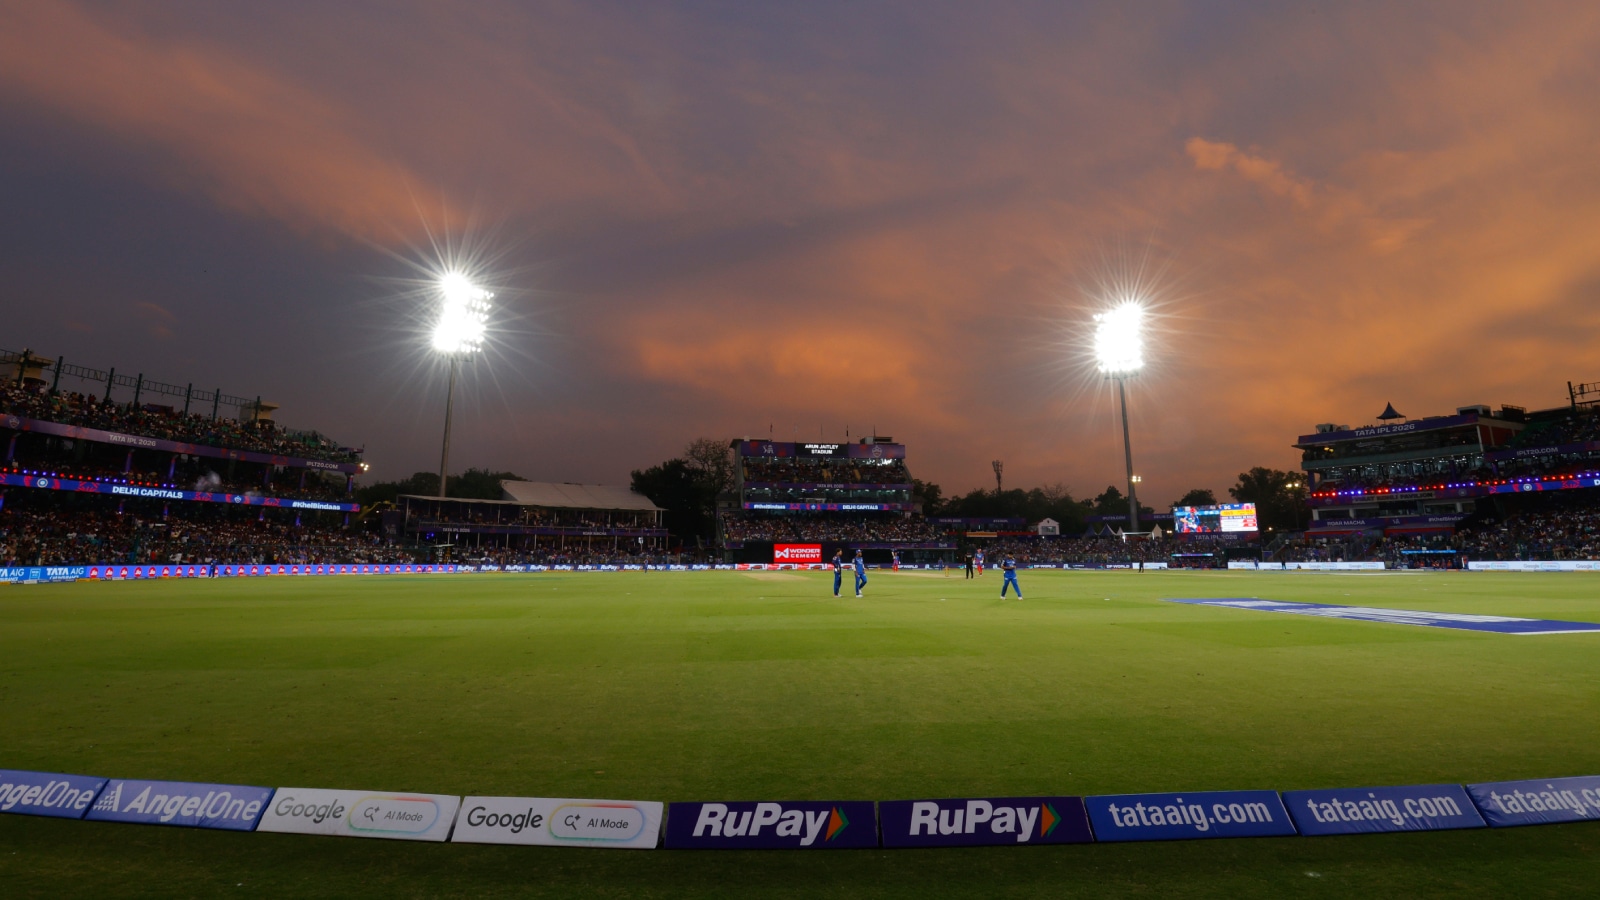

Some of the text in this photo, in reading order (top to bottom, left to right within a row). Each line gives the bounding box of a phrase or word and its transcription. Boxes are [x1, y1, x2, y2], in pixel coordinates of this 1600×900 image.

[1354, 429, 1376, 437] TATA
[1392, 423, 1415, 432] 2026
[109, 434, 156, 447] TATA IPL 2026
[1516, 447, 1559, 456] IPLT20.COM
[306, 461, 338, 470] IPLT20.COM
[112, 486, 184, 499] DELHI CAPITALS
[9, 568, 25, 577] AIG
[46, 568, 69, 576] TATA
[70, 567, 84, 575] AIG
[123, 785, 261, 823] AngelOne
[275, 796, 345, 824] Google
[1307, 792, 1462, 826] tataaig.com
[384, 811, 424, 822] AI Mode
[467, 806, 543, 834] Google
[1108, 797, 1274, 832] tataaig.com
[587, 818, 629, 829] AI Mode
[692, 802, 830, 846] RuPay
[909, 800, 1040, 843] RuPay
